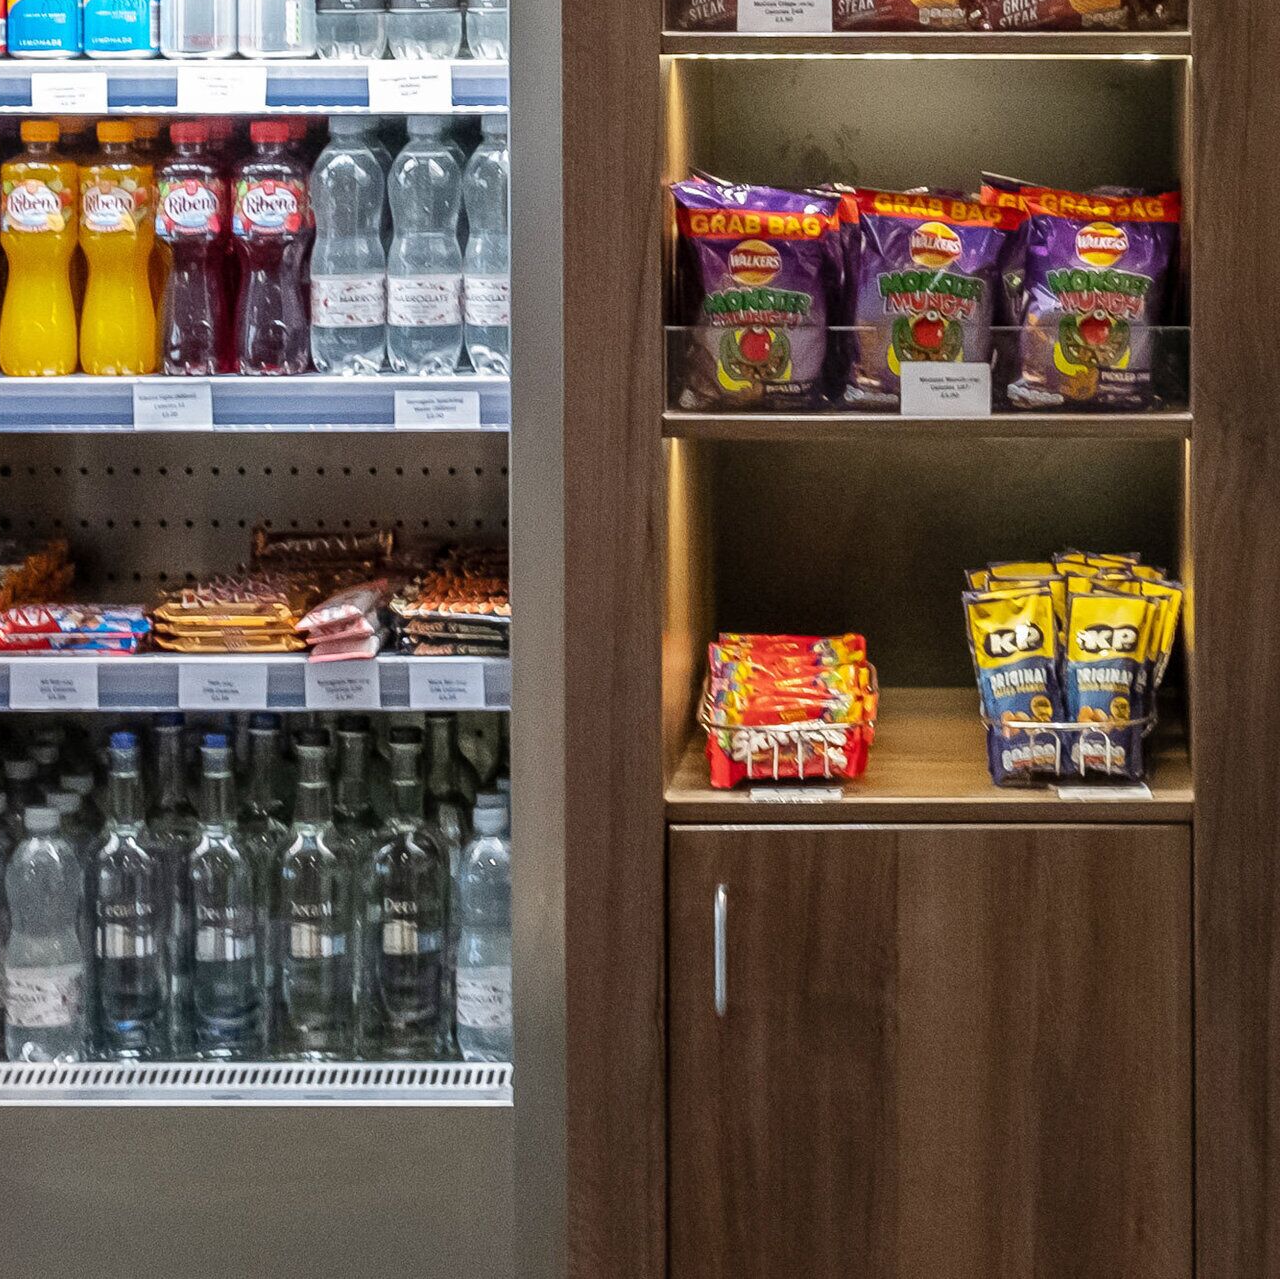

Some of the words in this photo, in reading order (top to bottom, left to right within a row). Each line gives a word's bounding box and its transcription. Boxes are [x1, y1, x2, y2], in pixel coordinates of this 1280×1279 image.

[9, 192, 60, 215] Ribena
[84, 193, 134, 215] Ribena
[168, 193, 218, 215] Ribena
[246, 193, 299, 216] Ribena
[873, 193, 945, 217] GRAB
[949, 200, 1003, 223] BAG
[1039, 192, 1112, 217] GRAB
[1113, 197, 1165, 218] BAG
[690, 213, 761, 235] GRAB
[767, 215, 822, 237] BAG
[910, 234, 961, 253] WALKERS
[1078, 232, 1128, 251] WALKERS
[730, 253, 781, 269] WALKERS
[704, 288, 812, 315] MONSTER
[885, 290, 977, 317] MUNCH
[1057, 290, 1144, 315] MUNCH
[988, 623, 1041, 655] KP
[1082, 628, 1138, 652] KP
